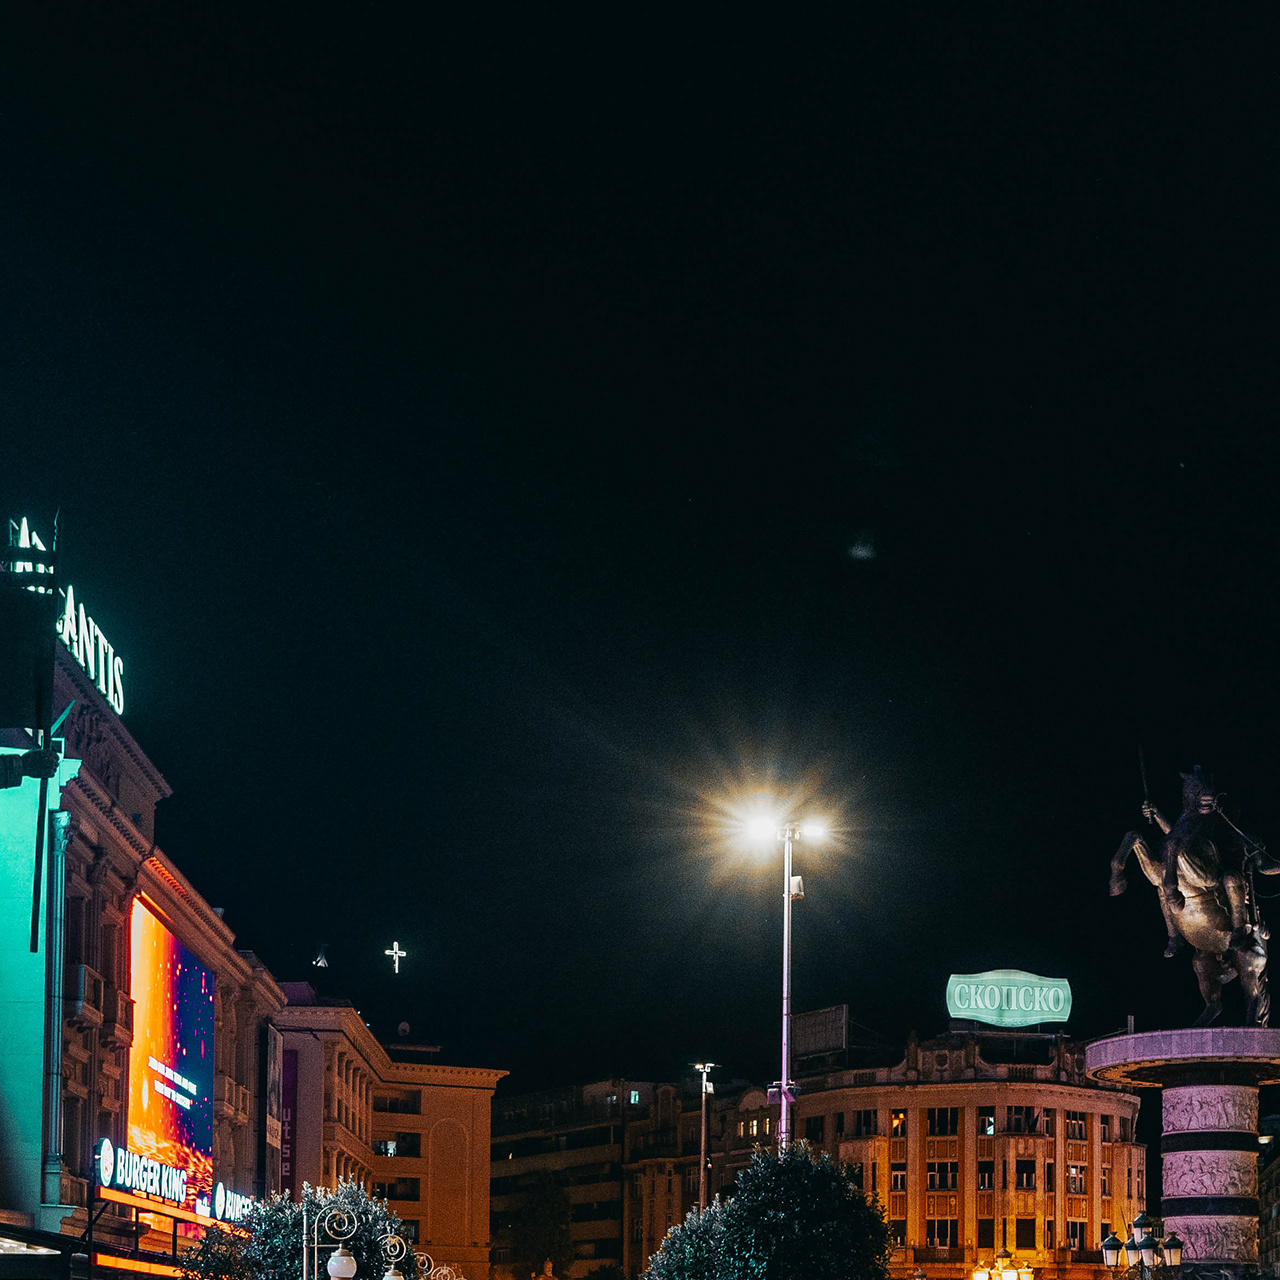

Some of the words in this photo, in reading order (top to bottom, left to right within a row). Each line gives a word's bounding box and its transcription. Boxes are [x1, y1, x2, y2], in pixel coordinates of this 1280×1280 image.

[953, 984, 1066, 1013] СКОПСКО
[116, 1147, 161, 1196] BURGER
[161, 1164, 187, 1203] KING
